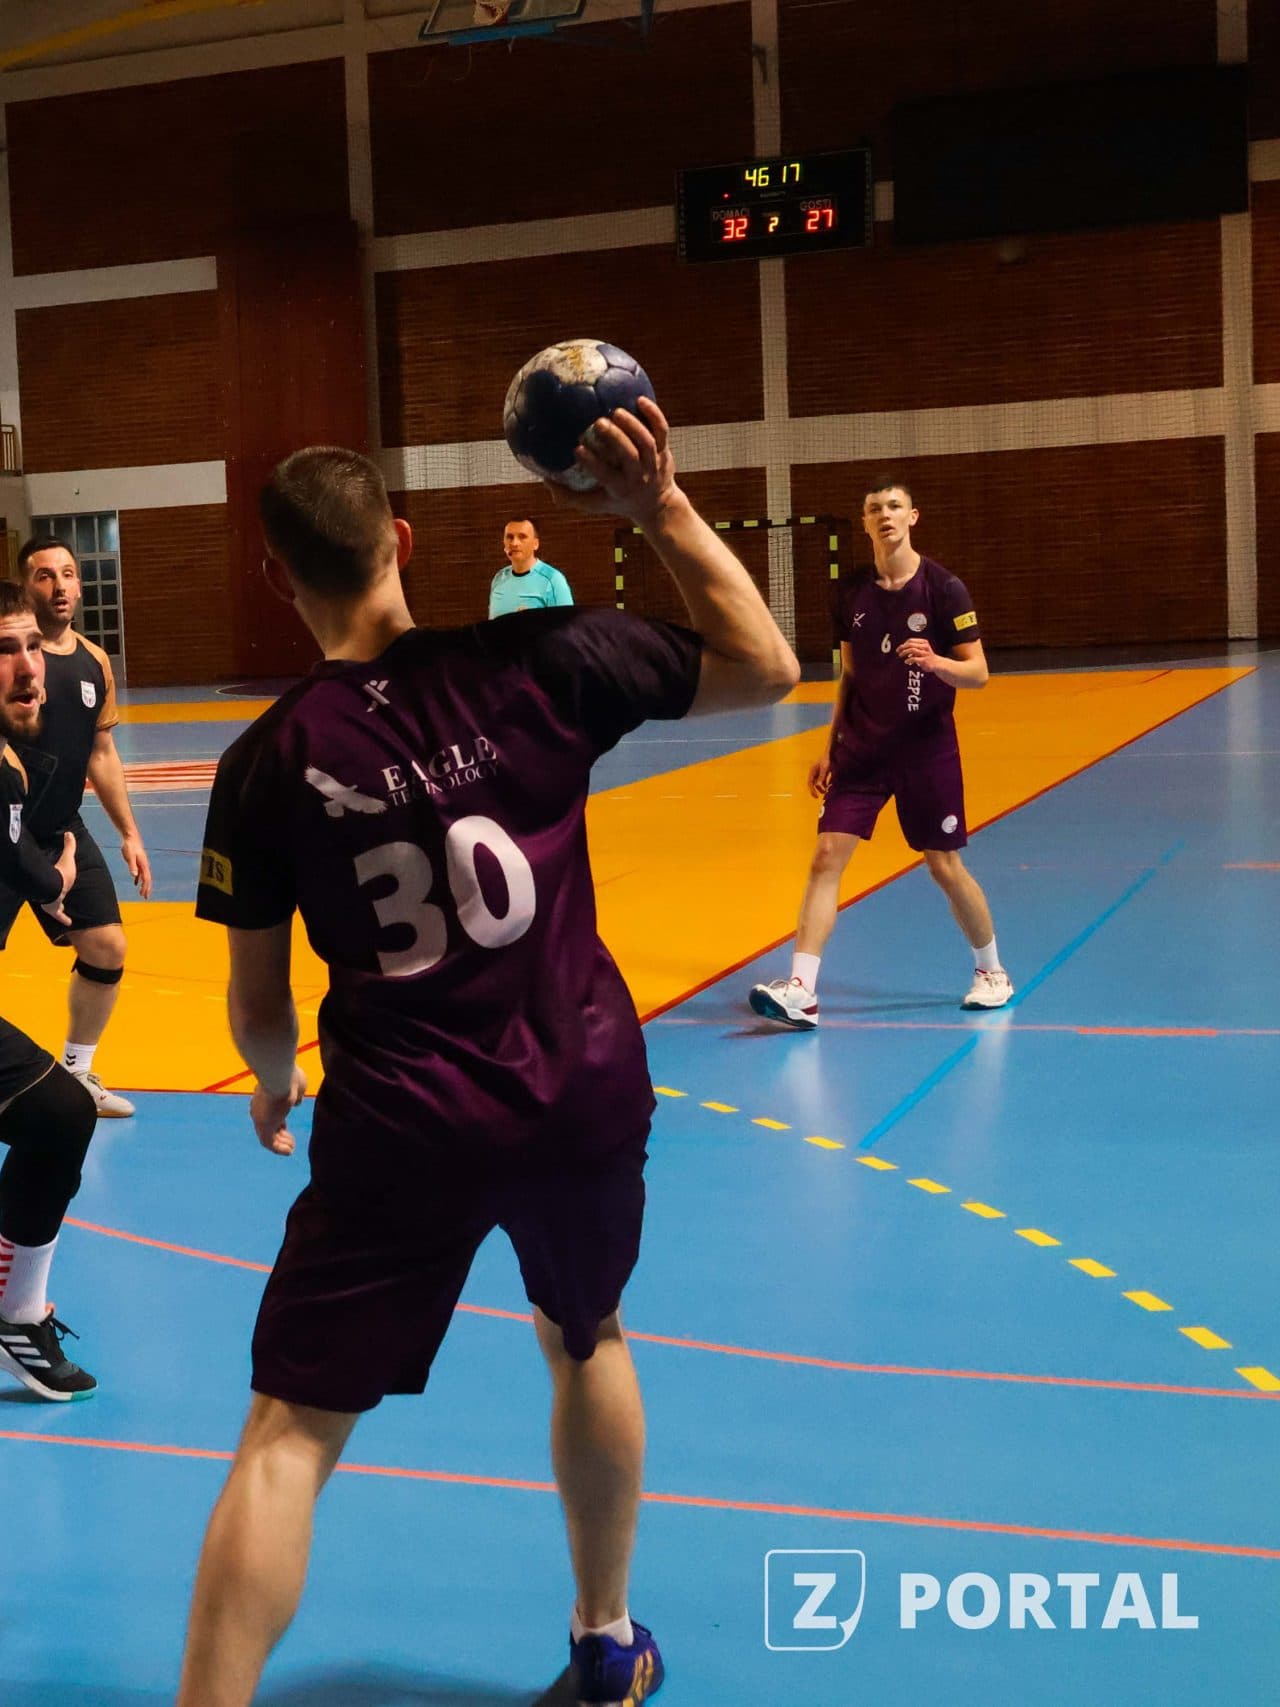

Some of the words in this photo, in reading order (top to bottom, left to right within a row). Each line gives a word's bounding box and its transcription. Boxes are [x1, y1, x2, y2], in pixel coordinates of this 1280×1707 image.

[745, 167, 770, 187] 46
[782, 163, 801, 183] 17
[722, 218, 748, 239] 32
[807, 209, 833, 230] 27
[881, 633, 892, 654] 6
[353, 815, 537, 977] 30
